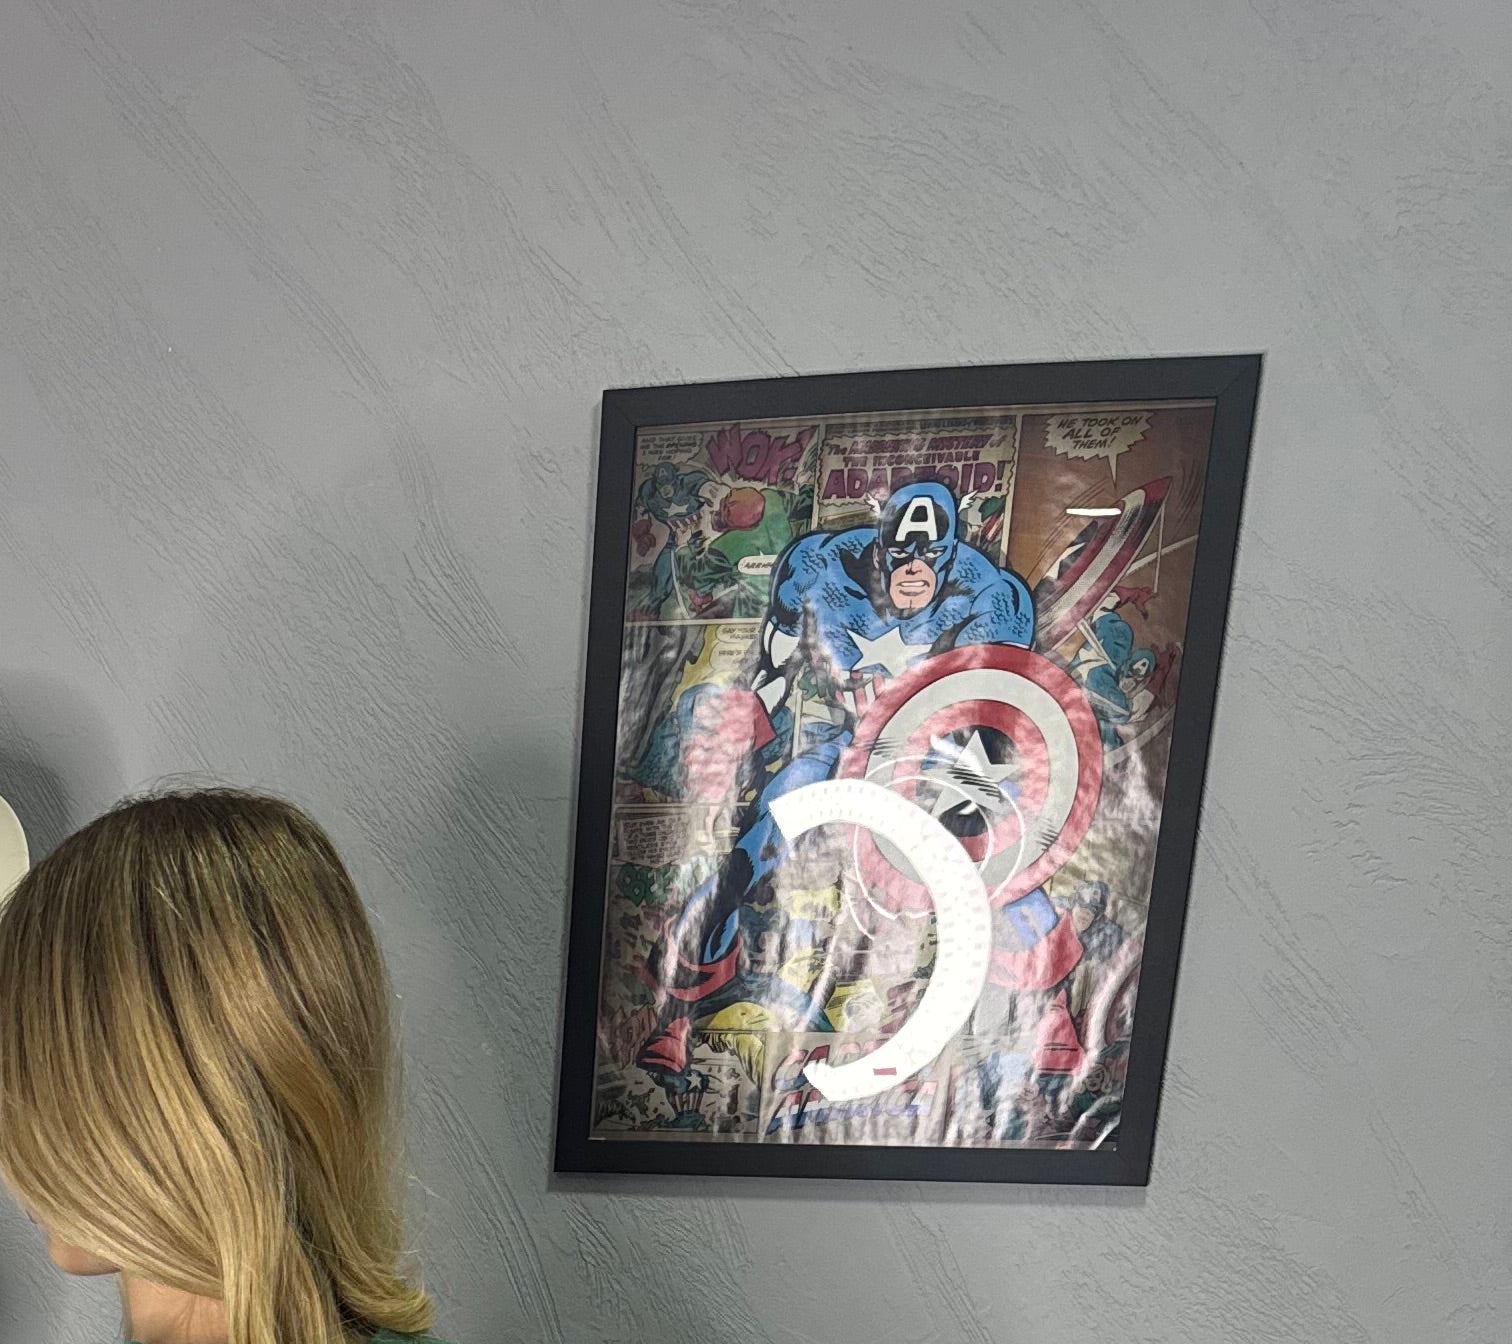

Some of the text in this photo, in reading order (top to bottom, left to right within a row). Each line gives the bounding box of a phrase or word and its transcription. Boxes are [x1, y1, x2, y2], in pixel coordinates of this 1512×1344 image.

[1057, 415, 1143, 429] HE TOOK ON
[1062, 427, 1121, 440] ALL OF
[1073, 436, 1116, 449] THEM!
[895, 496, 938, 542] A
